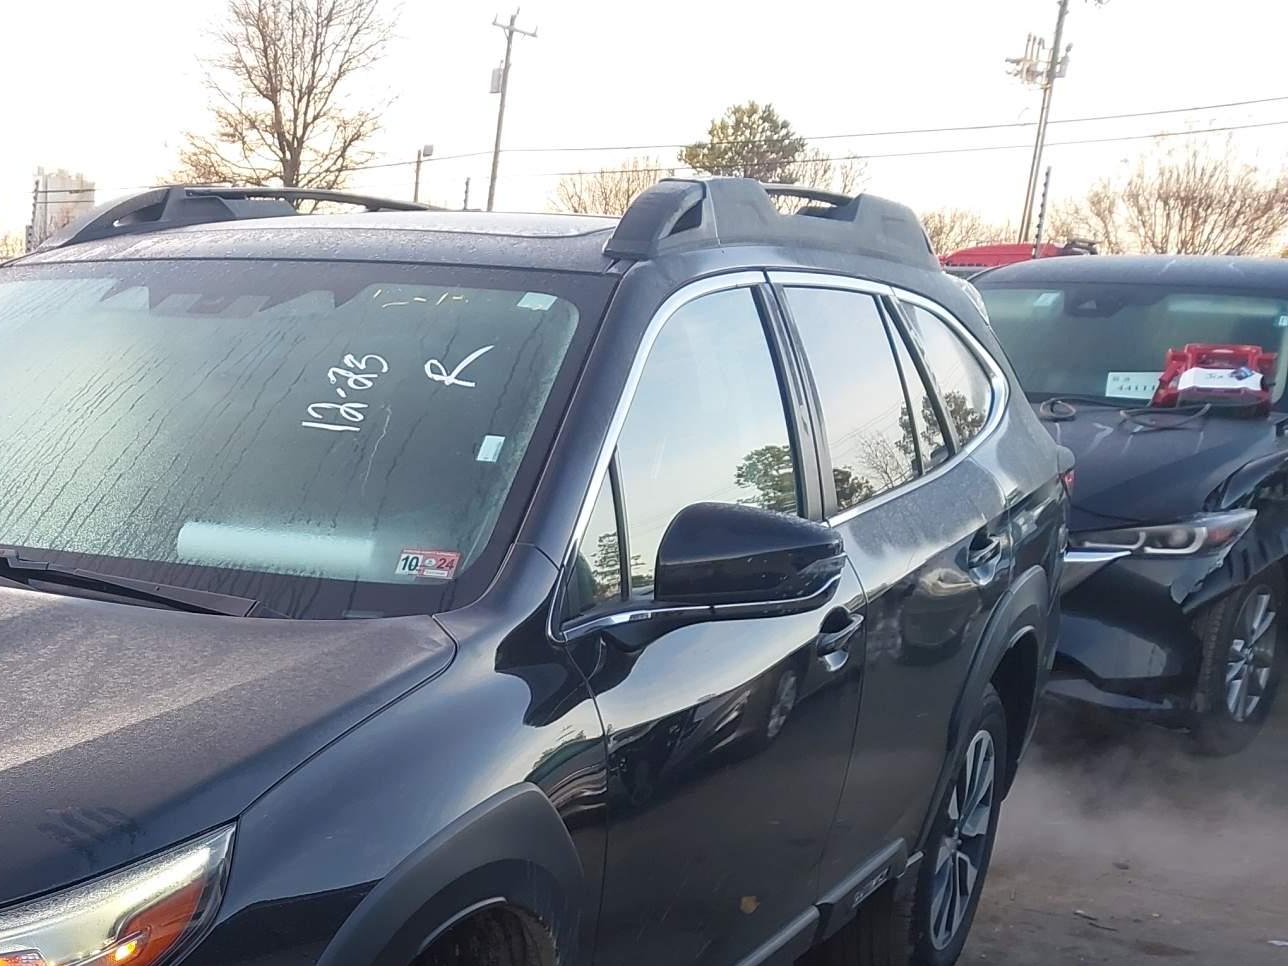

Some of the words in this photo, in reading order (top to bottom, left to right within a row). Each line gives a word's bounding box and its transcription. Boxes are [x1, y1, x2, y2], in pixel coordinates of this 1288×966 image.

[424, 345, 495, 387] R
[401, 555, 420, 571] 10
[436, 557, 455, 570] 24
